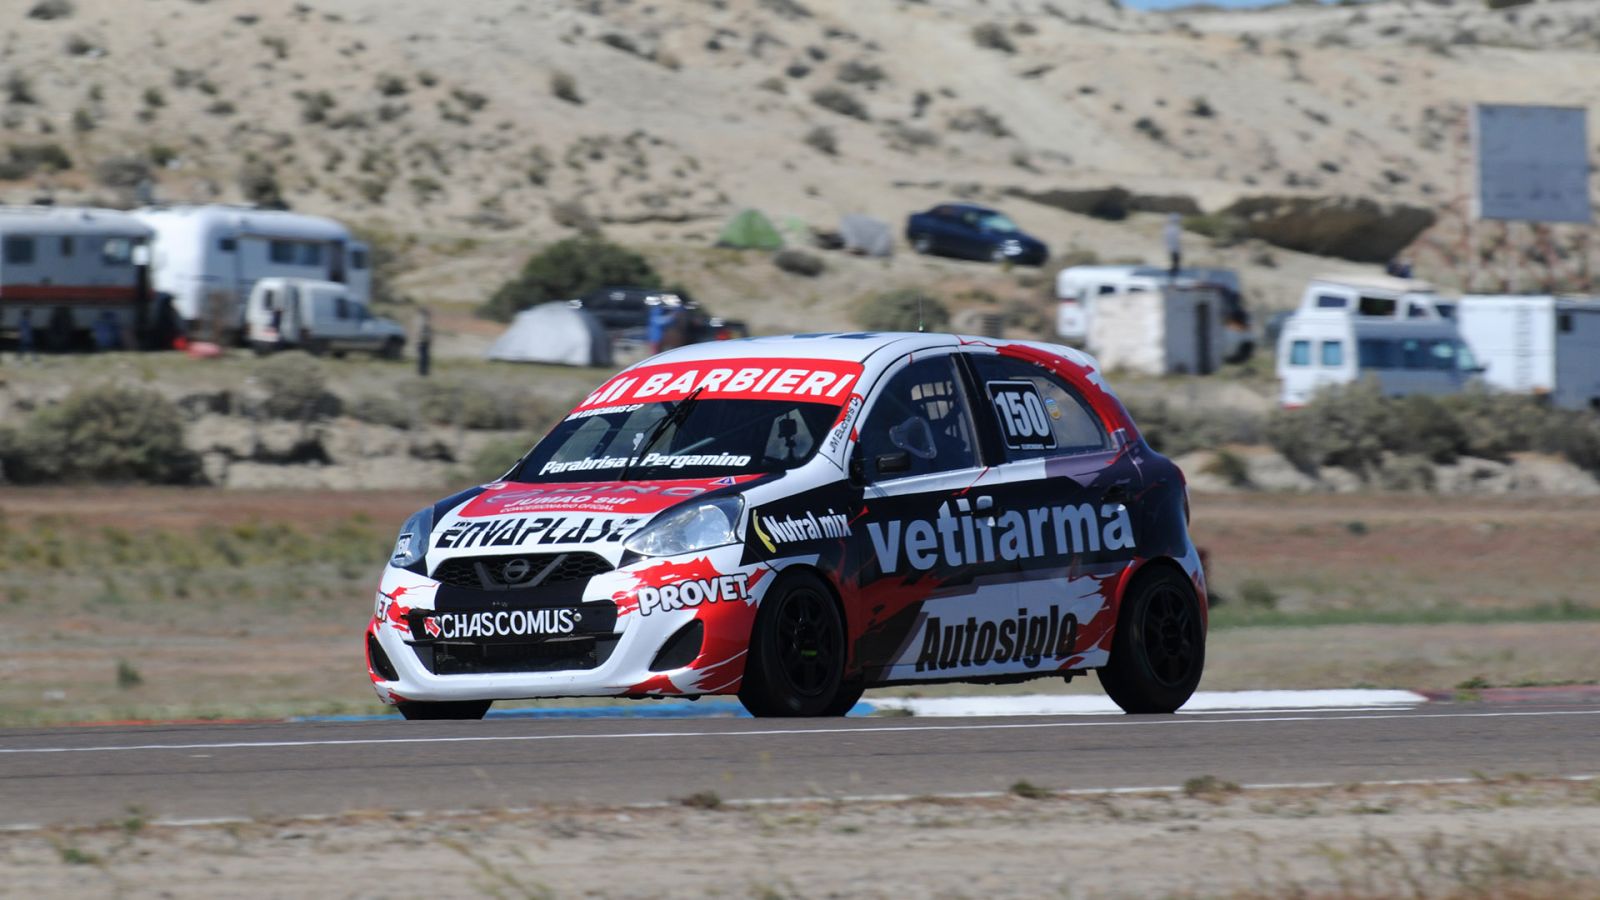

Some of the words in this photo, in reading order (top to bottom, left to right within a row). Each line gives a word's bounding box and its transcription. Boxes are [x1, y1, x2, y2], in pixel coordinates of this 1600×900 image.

[632, 368, 855, 398] BARBIERI
[994, 391, 1050, 437] 150
[640, 453, 751, 470] Pergamino
[762, 510, 823, 544] Nutral
[818, 508, 852, 539] mix
[866, 495, 1136, 574] vetifarma
[636, 572, 750, 617] PROVET
[441, 609, 575, 639] CHASCOMUS
[915, 605, 1078, 672] Autosiglo
